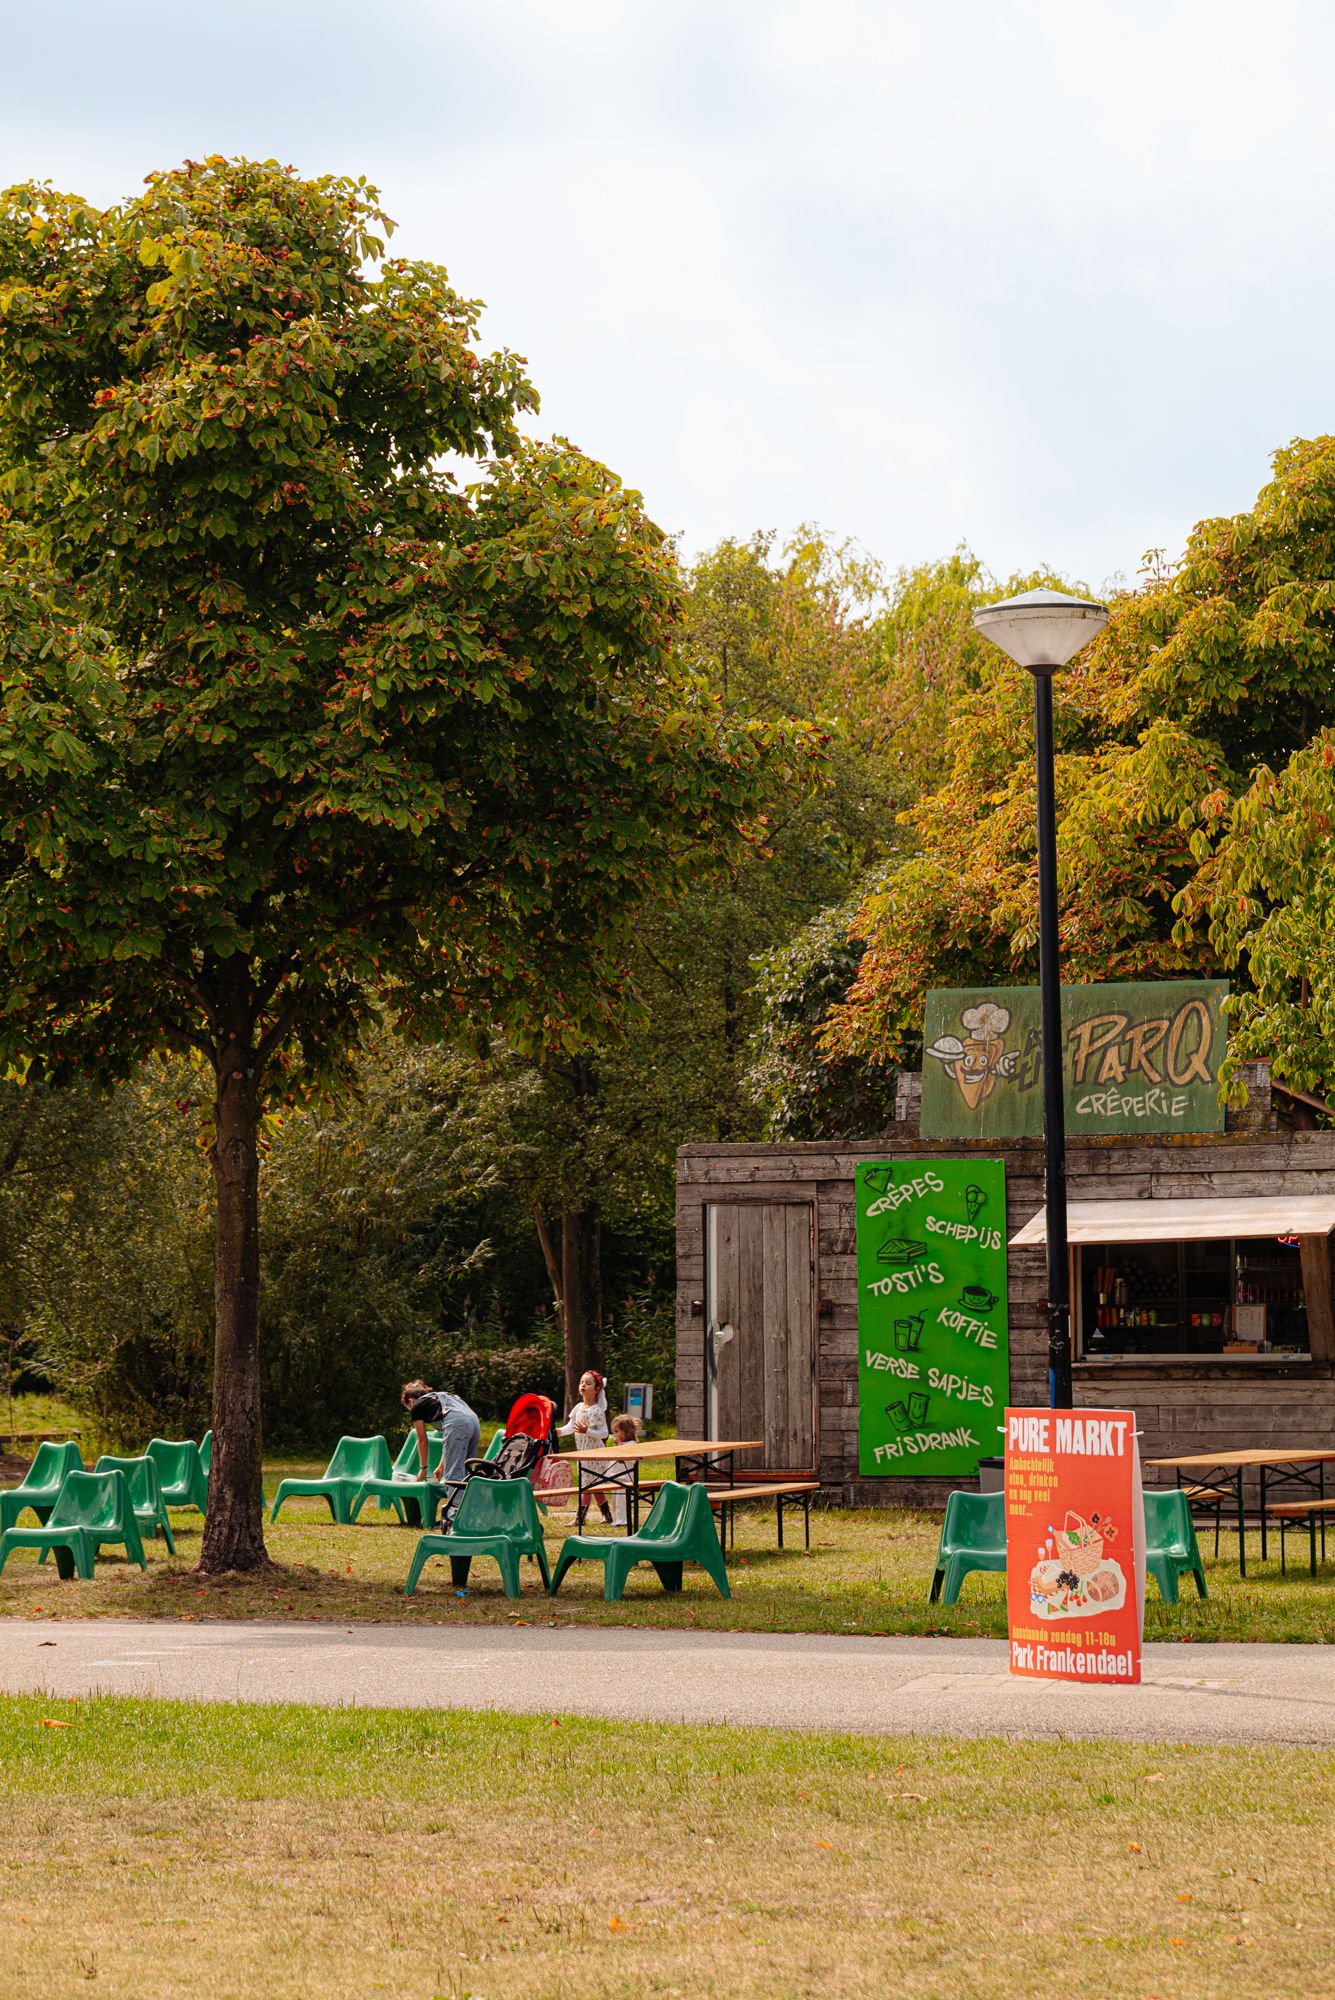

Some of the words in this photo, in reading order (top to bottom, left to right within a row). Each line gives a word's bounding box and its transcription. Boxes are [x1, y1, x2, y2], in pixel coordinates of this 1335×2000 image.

[1068, 999, 1212, 1087] PARQ
[866, 1172, 944, 1217] CRÊPES
[865, 1350, 920, 1380] VERSE
[1009, 1416, 1050, 1453] PURE
[1055, 1418, 1127, 1456] MARKT
[1009, 1488, 1018, 1501] en
[1020, 1489, 1032, 1504] nog
[1034, 1489, 1051, 1502] veel
[1028, 1473, 1058, 1487] drinken
[1051, 1629, 1082, 1647] zondag
[1085, 1631, 1117, 1646] 11-18u
[1012, 1641, 1034, 1670] Park
[1036, 1645, 1133, 1677] Frankendael
